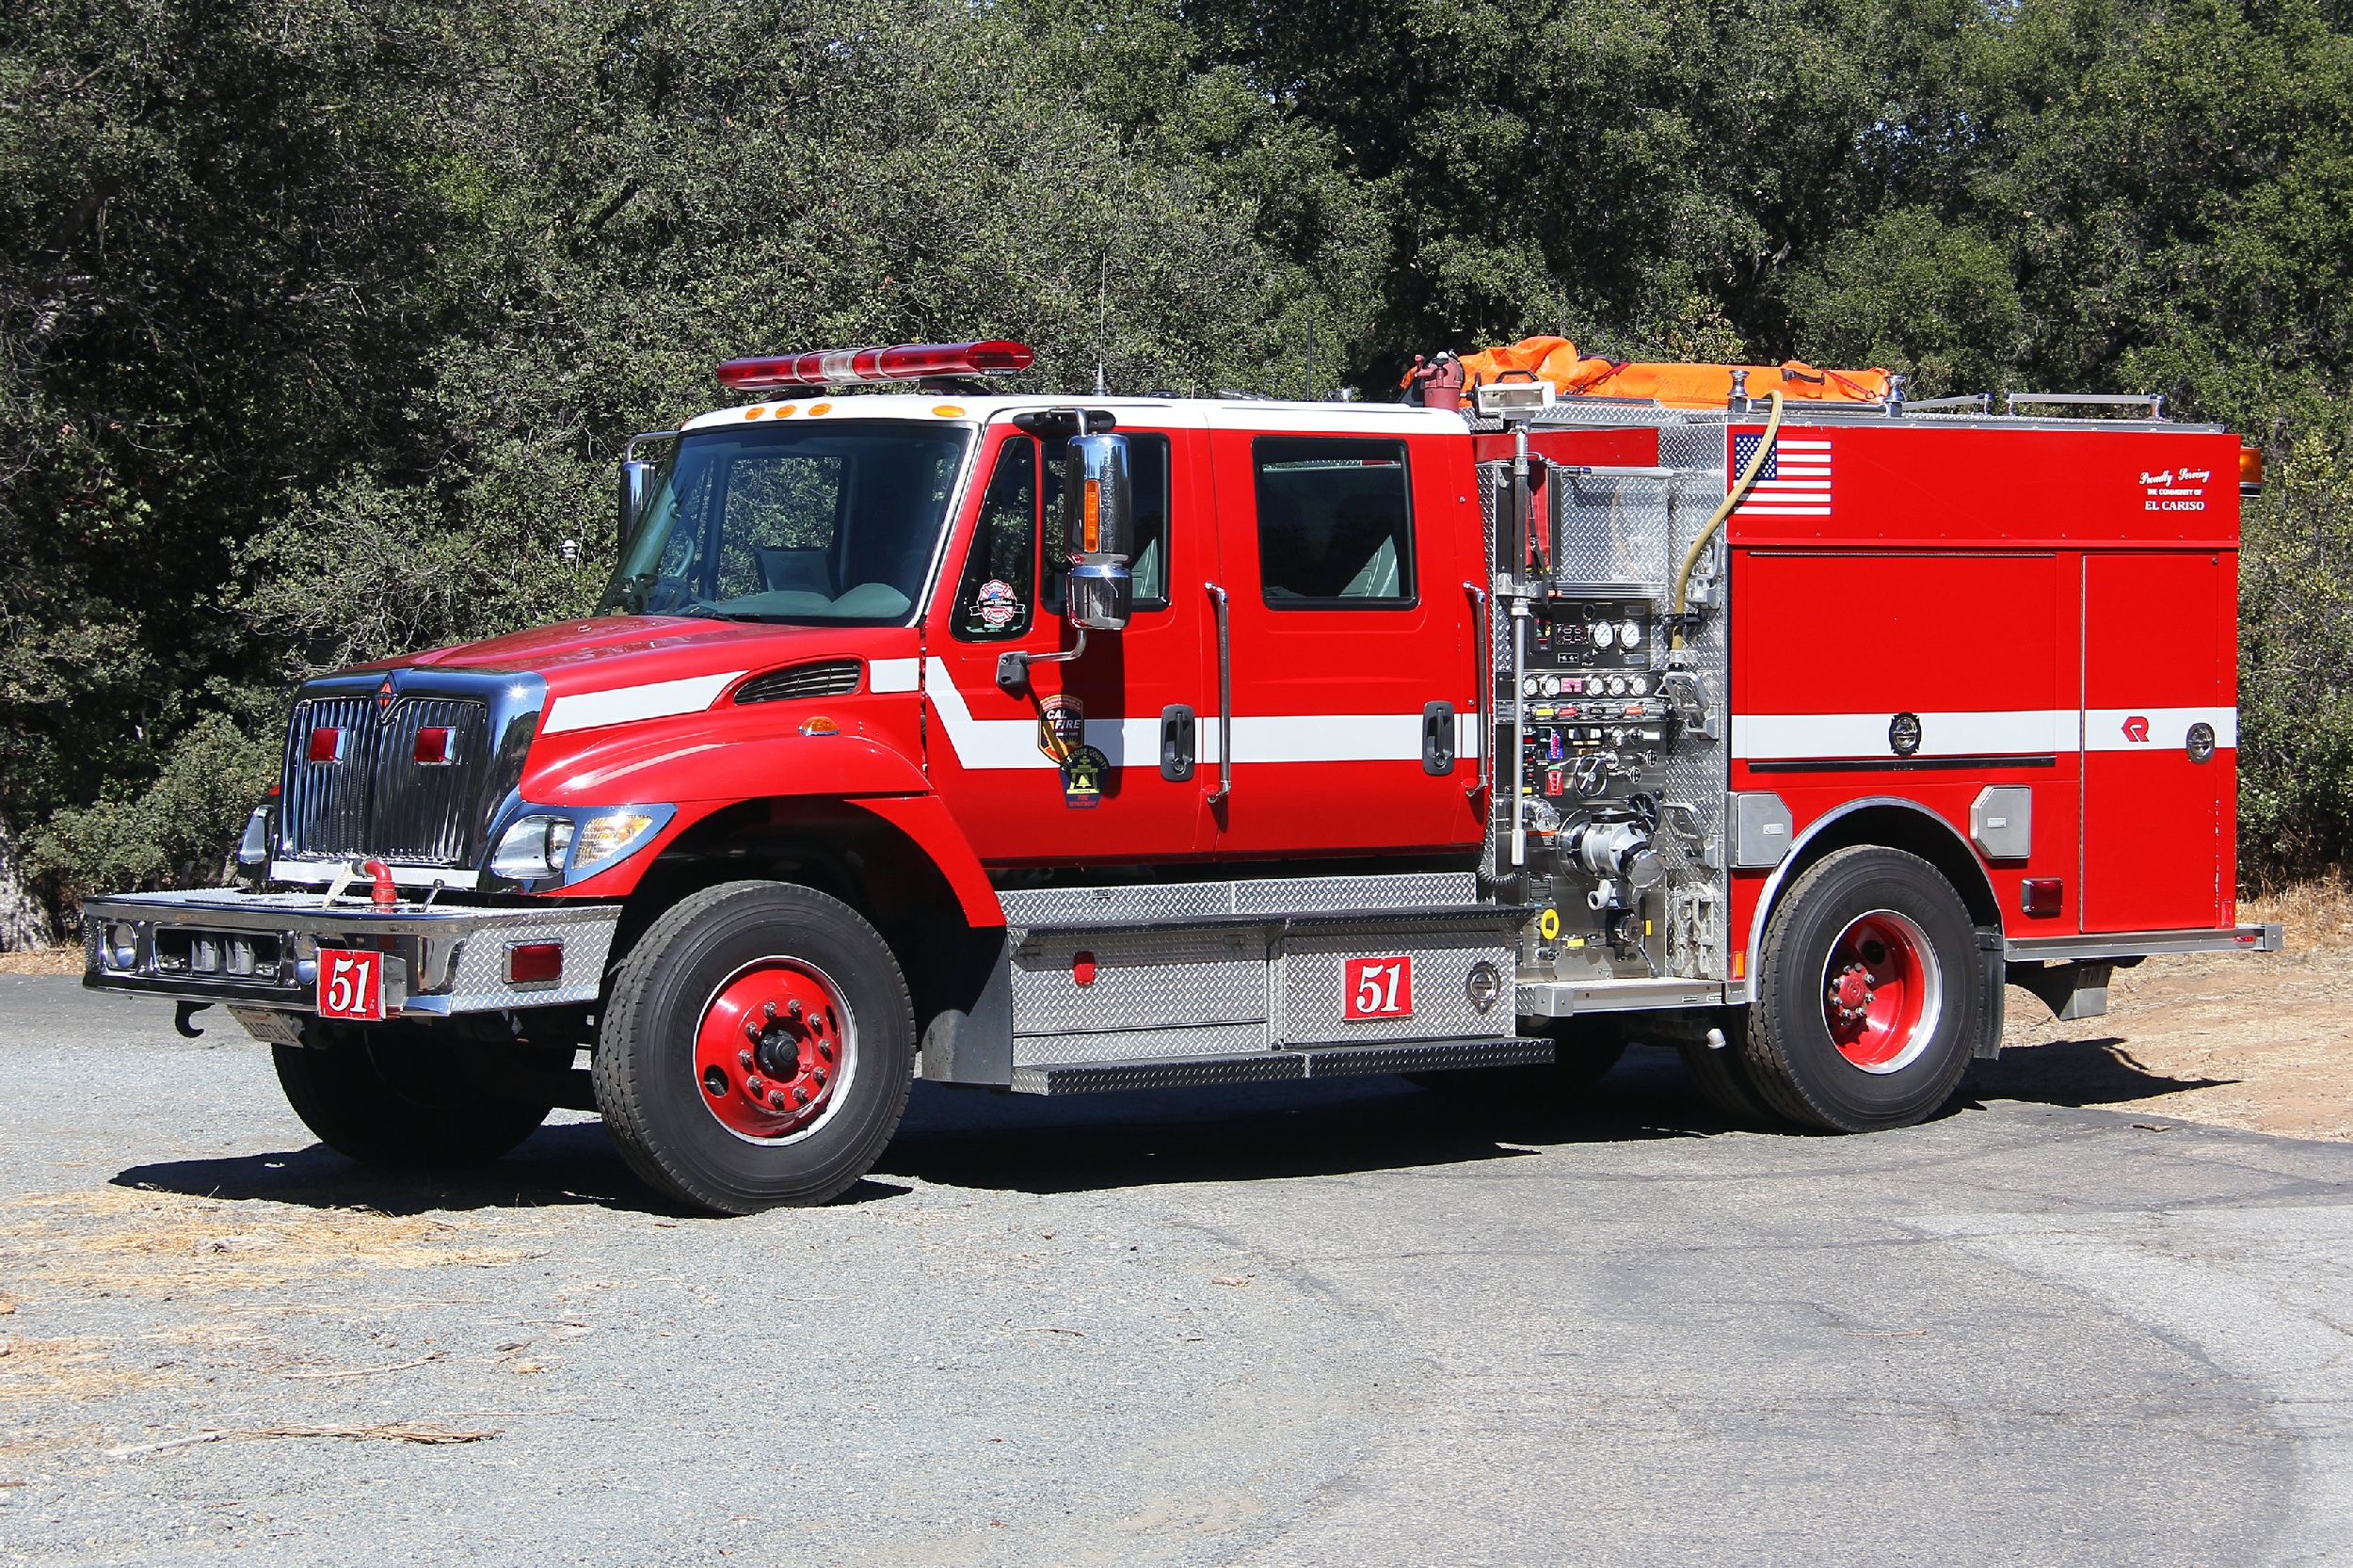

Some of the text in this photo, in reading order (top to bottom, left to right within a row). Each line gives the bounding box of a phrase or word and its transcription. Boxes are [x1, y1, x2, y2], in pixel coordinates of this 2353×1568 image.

[2139, 468, 2210, 487] Proudly Serving
[2145, 501, 2204, 510] EL CARISO
[1046, 709, 1067, 720] CAL
[1055, 719, 1081, 729] FIRE
[1061, 748, 1109, 771] RIVERSIDE COUNTY
[328, 957, 370, 1013] 51
[1356, 964, 1401, 1013] 51
